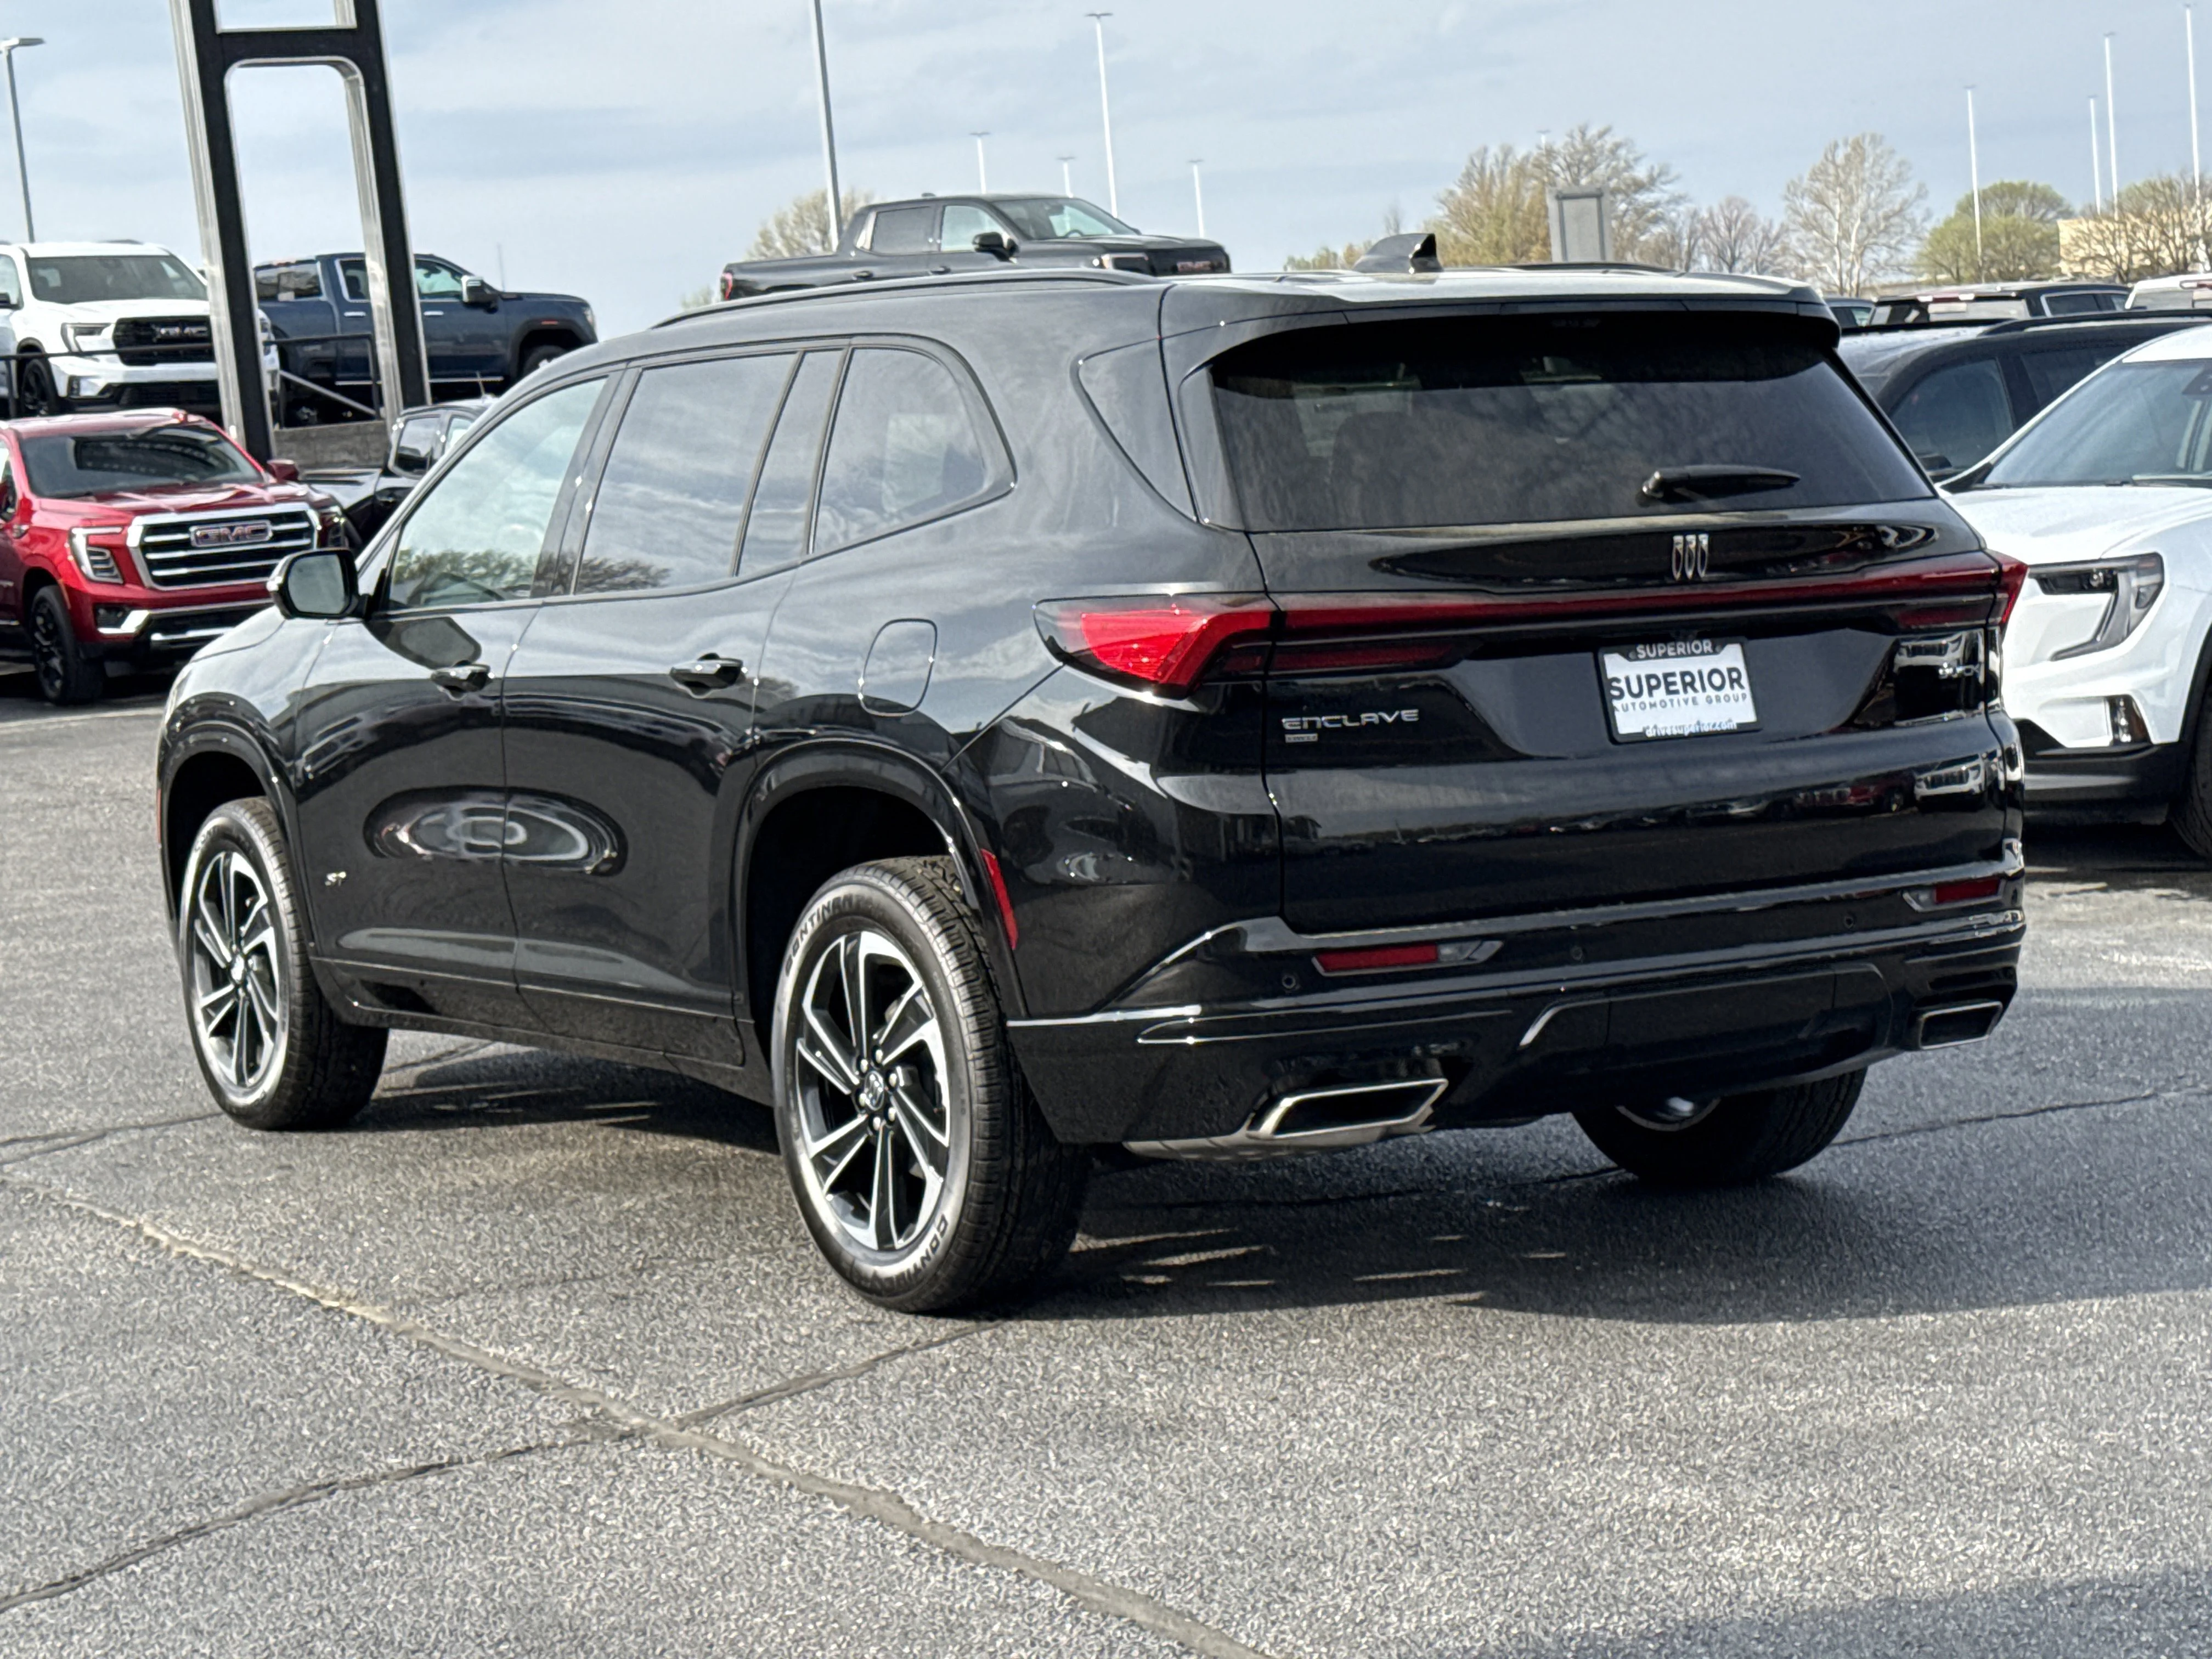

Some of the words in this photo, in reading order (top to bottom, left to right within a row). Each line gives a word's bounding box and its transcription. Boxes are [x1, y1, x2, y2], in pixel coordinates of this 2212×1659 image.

[195, 524, 268, 545] GMC
[1637, 639, 1713, 659] SUPERIOR
[1938, 662, 1980, 679] BUICK
[1610, 667, 1746, 701] SUPERIOR
[1705, 692, 1747, 705] GROUP
[1282, 709, 1419, 730] ENCLAVE
